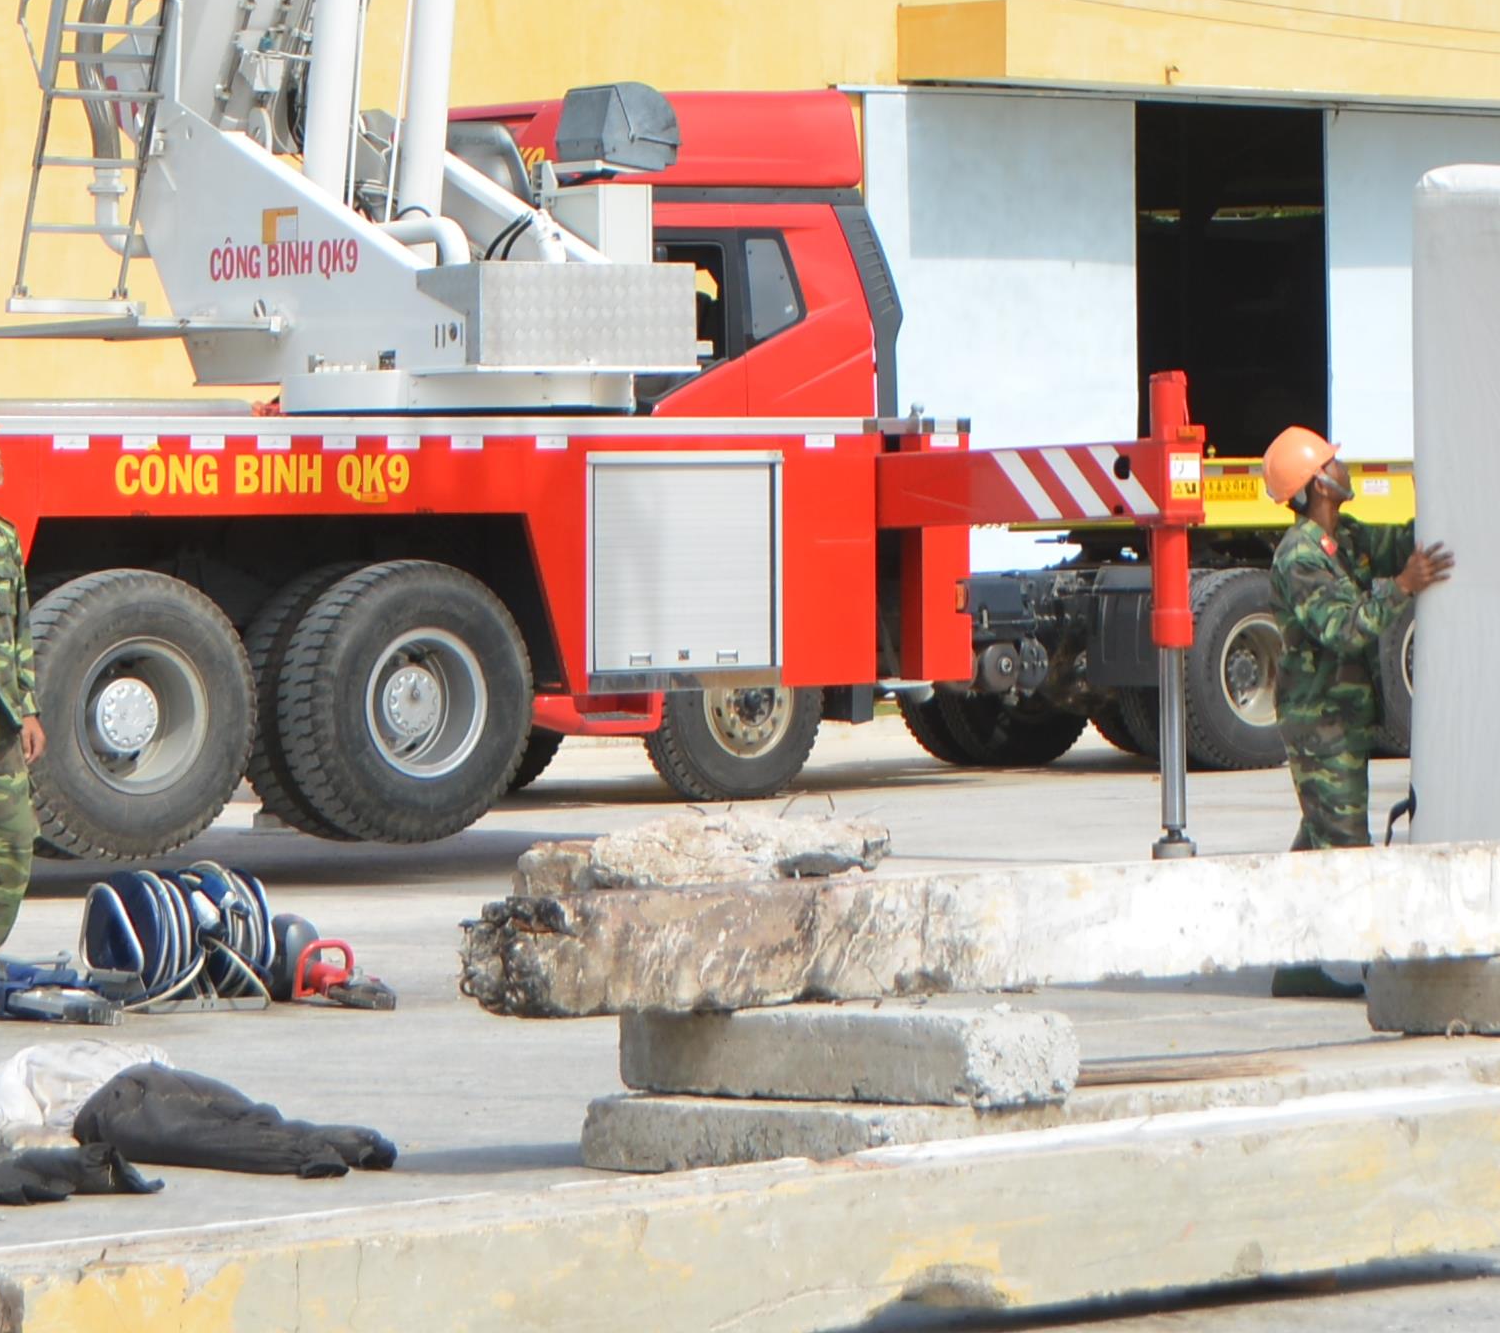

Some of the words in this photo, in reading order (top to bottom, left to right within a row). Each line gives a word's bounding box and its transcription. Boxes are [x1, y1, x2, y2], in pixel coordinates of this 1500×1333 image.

[210, 237, 261, 282] CÔNG
[267, 240, 313, 278] BINH
[318, 238, 359, 280] QK9
[115, 443, 218, 496] CÔNG
[235, 454, 322, 494] BINH
[337, 454, 410, 501] QK9
